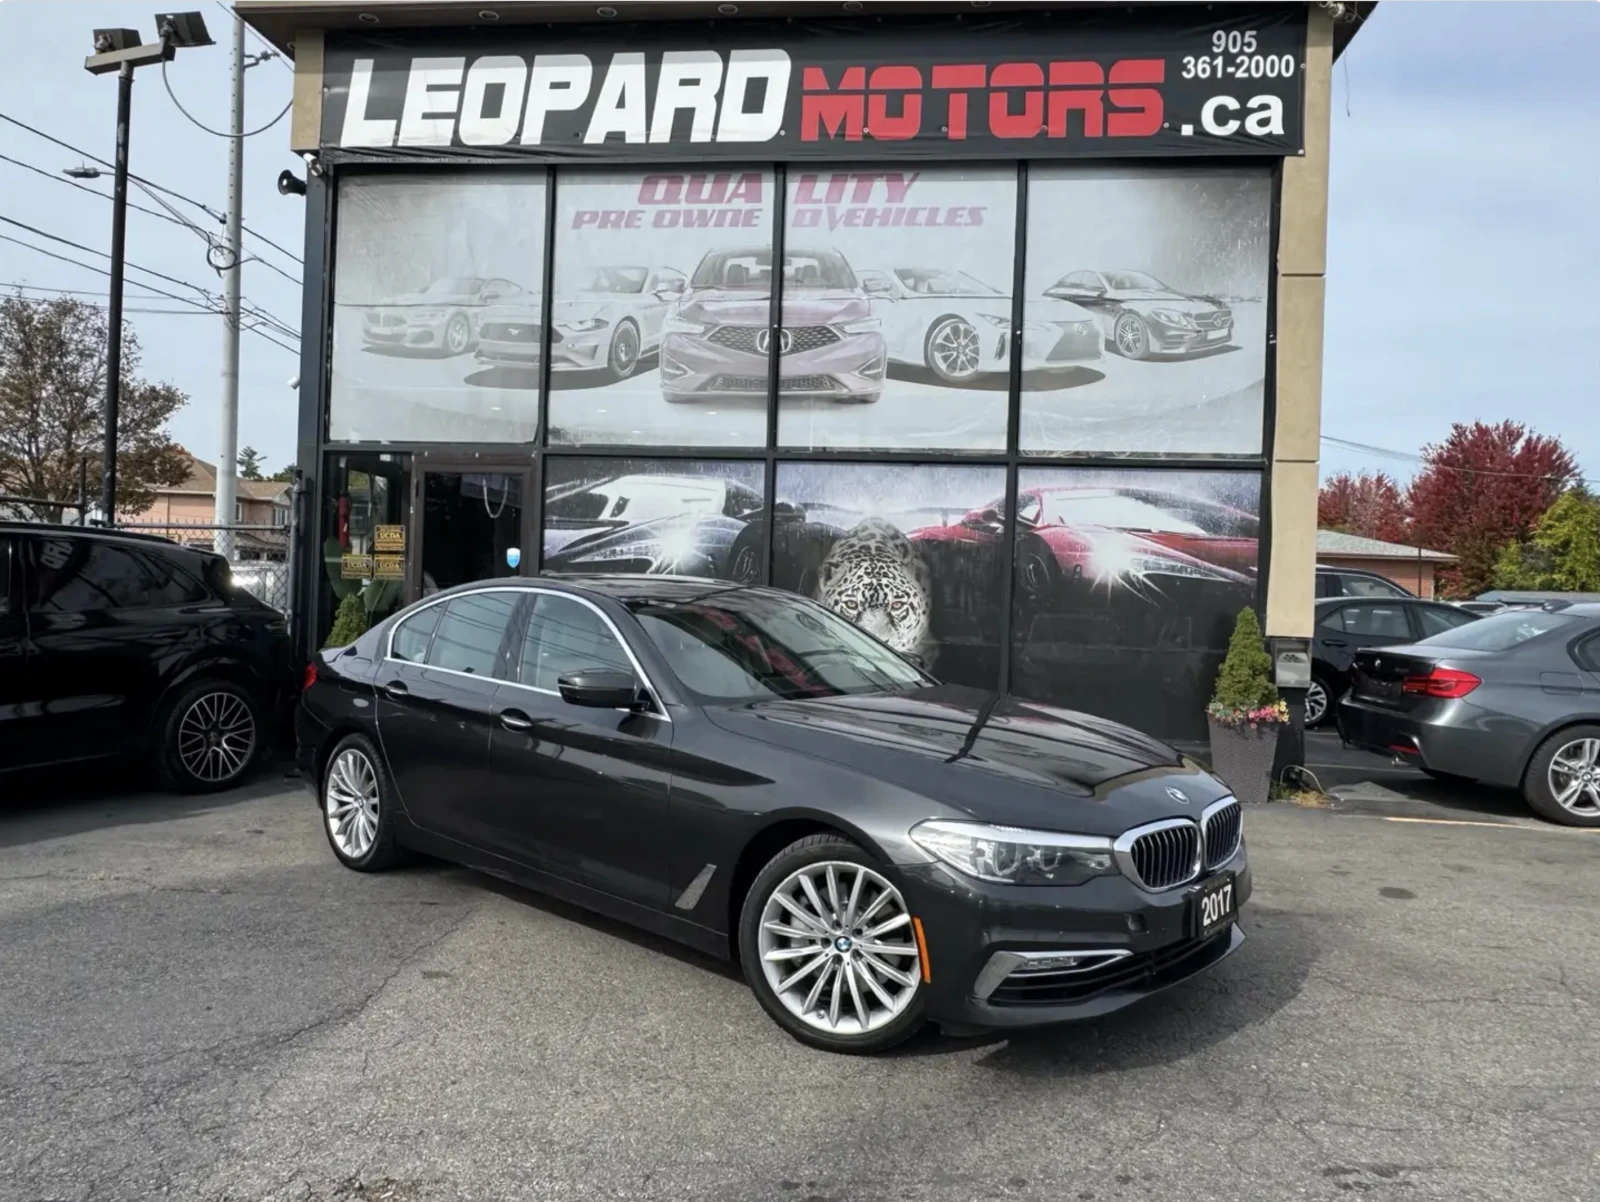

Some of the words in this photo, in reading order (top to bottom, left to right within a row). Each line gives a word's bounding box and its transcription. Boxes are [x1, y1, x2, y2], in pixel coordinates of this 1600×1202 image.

[1211, 30, 1258, 54] 905
[1181, 54, 1295, 79] 361-2000
[340, 48, 792, 148] LEOPARD
[800, 59, 1166, 141] MOTORS
[1181, 94, 1285, 136] .ca
[571, 210, 645, 230] PRE
[1201, 884, 1232, 927] 2017
